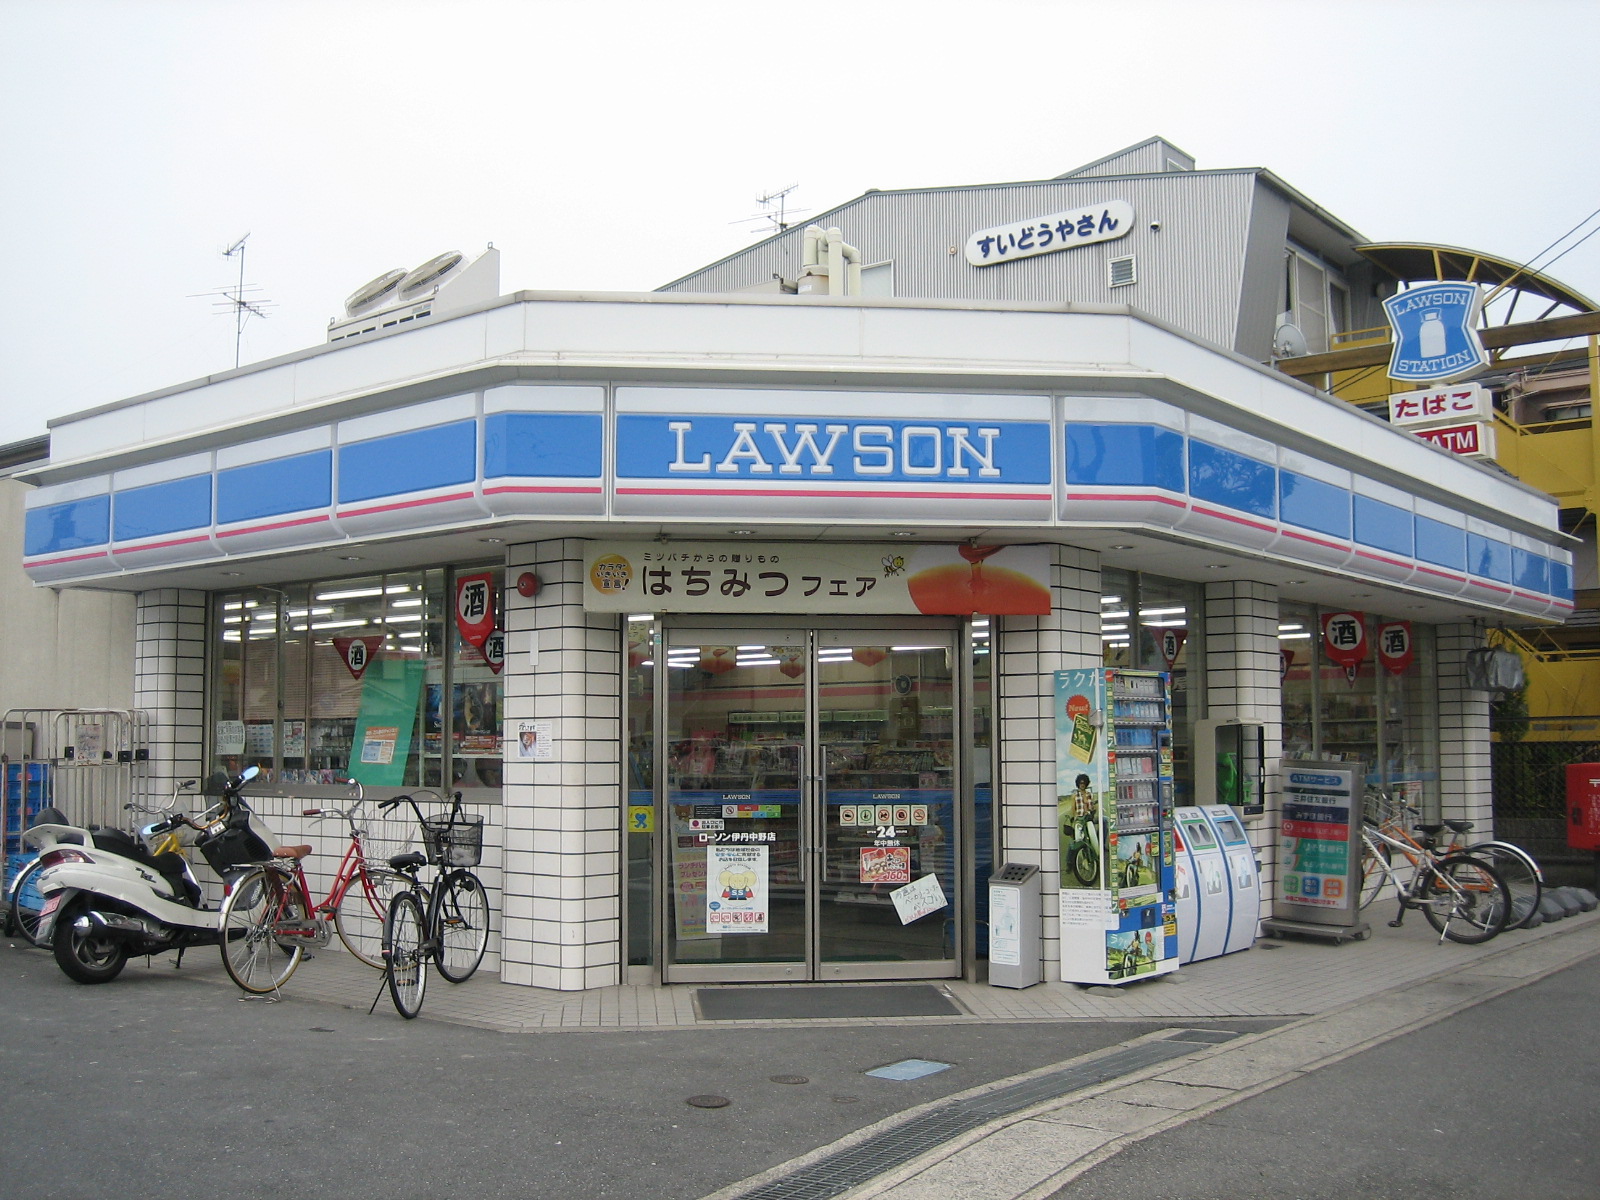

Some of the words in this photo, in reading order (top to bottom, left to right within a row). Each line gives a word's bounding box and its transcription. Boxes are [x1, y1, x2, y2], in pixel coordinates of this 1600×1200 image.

[976, 209, 1119, 258] すいどうやさん
[1393, 292, 1468, 317] LAWSON
[1398, 349, 1472, 373] STATION
[1395, 391, 1474, 419] たばこ
[668, 421, 1001, 477] LAWSON
[598, 563, 628, 571] カラダ
[643, 552, 780, 564] ミツバチからの贈りもの
[596, 570, 629, 579] いきいき
[463, 582, 486, 617] 酒
[1332, 619, 1358, 645] 酒
[1384, 629, 1406, 653] 酒
[350, 644, 364, 666] 酒
[489, 636, 504, 659] 酒
[1068, 704, 1089, 712] New!
[1292, 773, 1340, 785] ATMサービス
[1293, 794, 1337, 805] 三井住友銀行
[698, 832, 776, 842] ローソン伊丹中野店
[876, 825, 896, 838] 24
